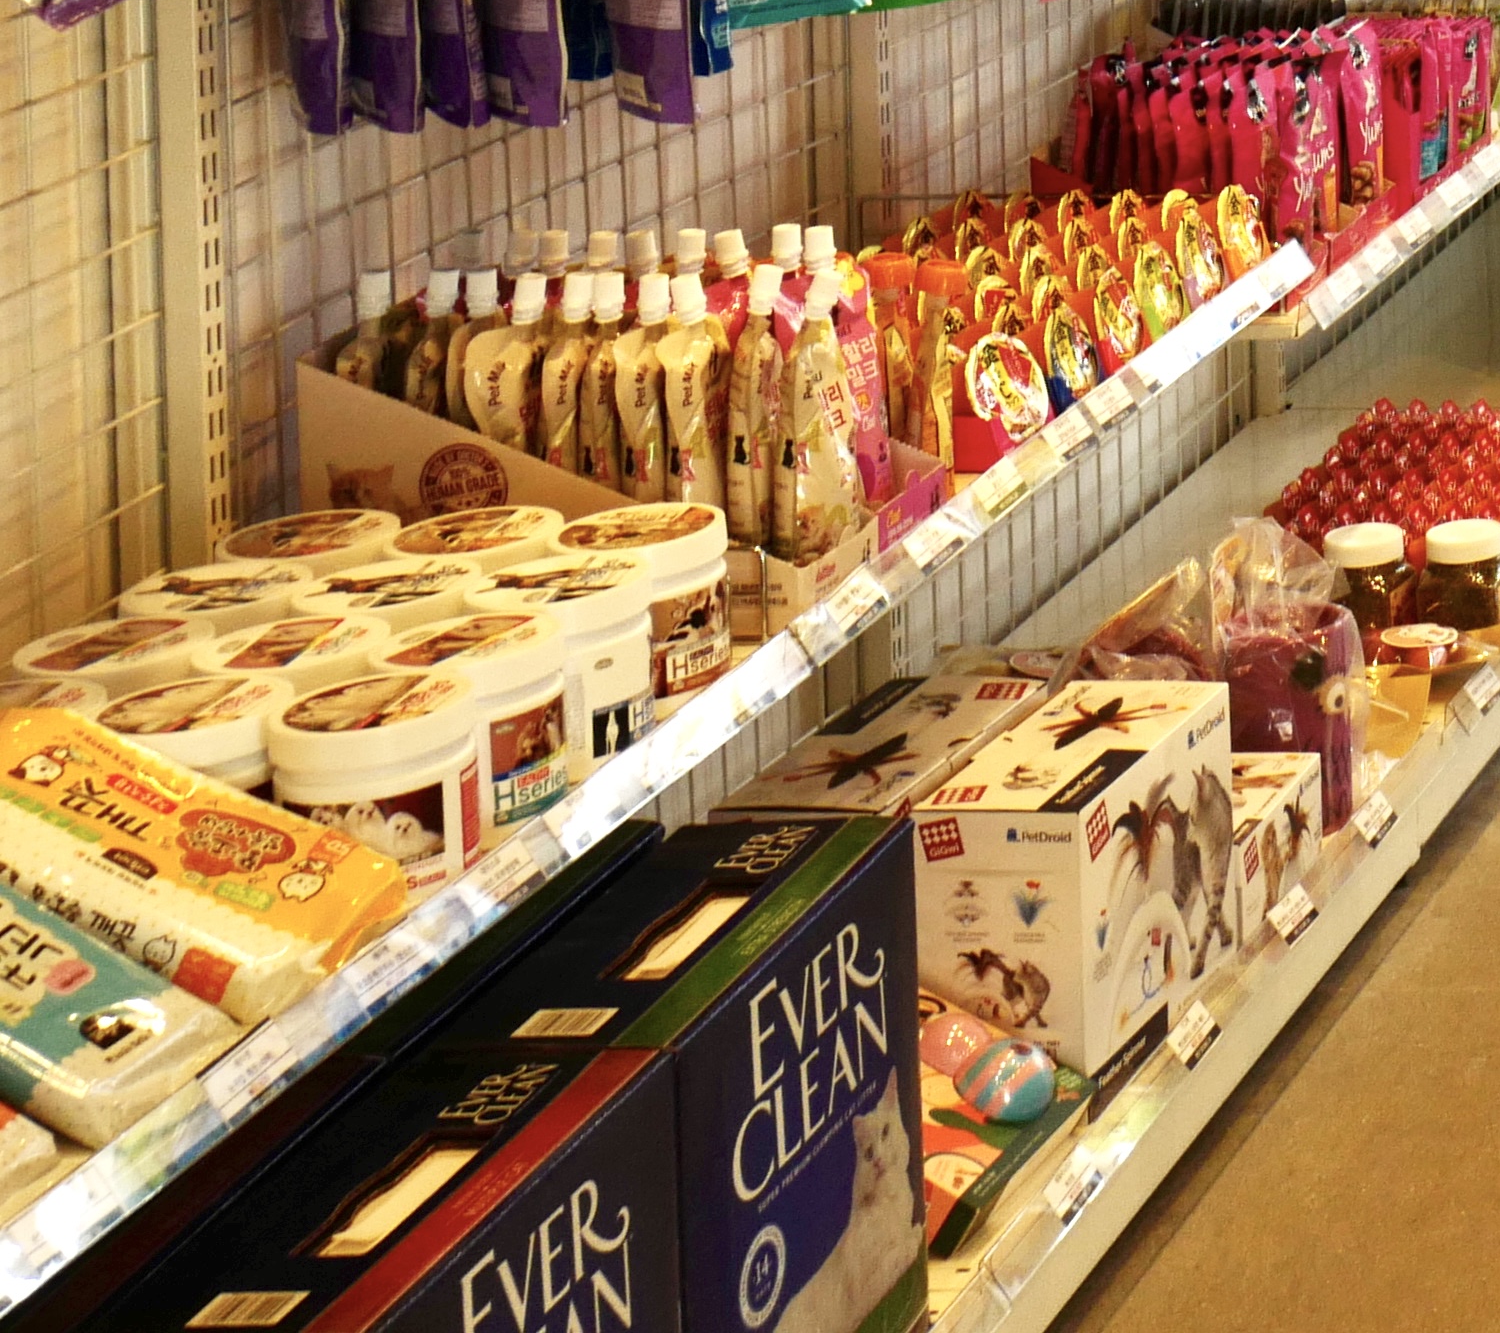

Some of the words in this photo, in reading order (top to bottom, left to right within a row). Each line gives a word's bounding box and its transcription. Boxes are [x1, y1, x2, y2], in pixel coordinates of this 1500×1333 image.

[1022, 828, 1071, 845] PetDroid
[732, 977, 890, 1209] CLEAN
[748, 922, 885, 1099] EVER
